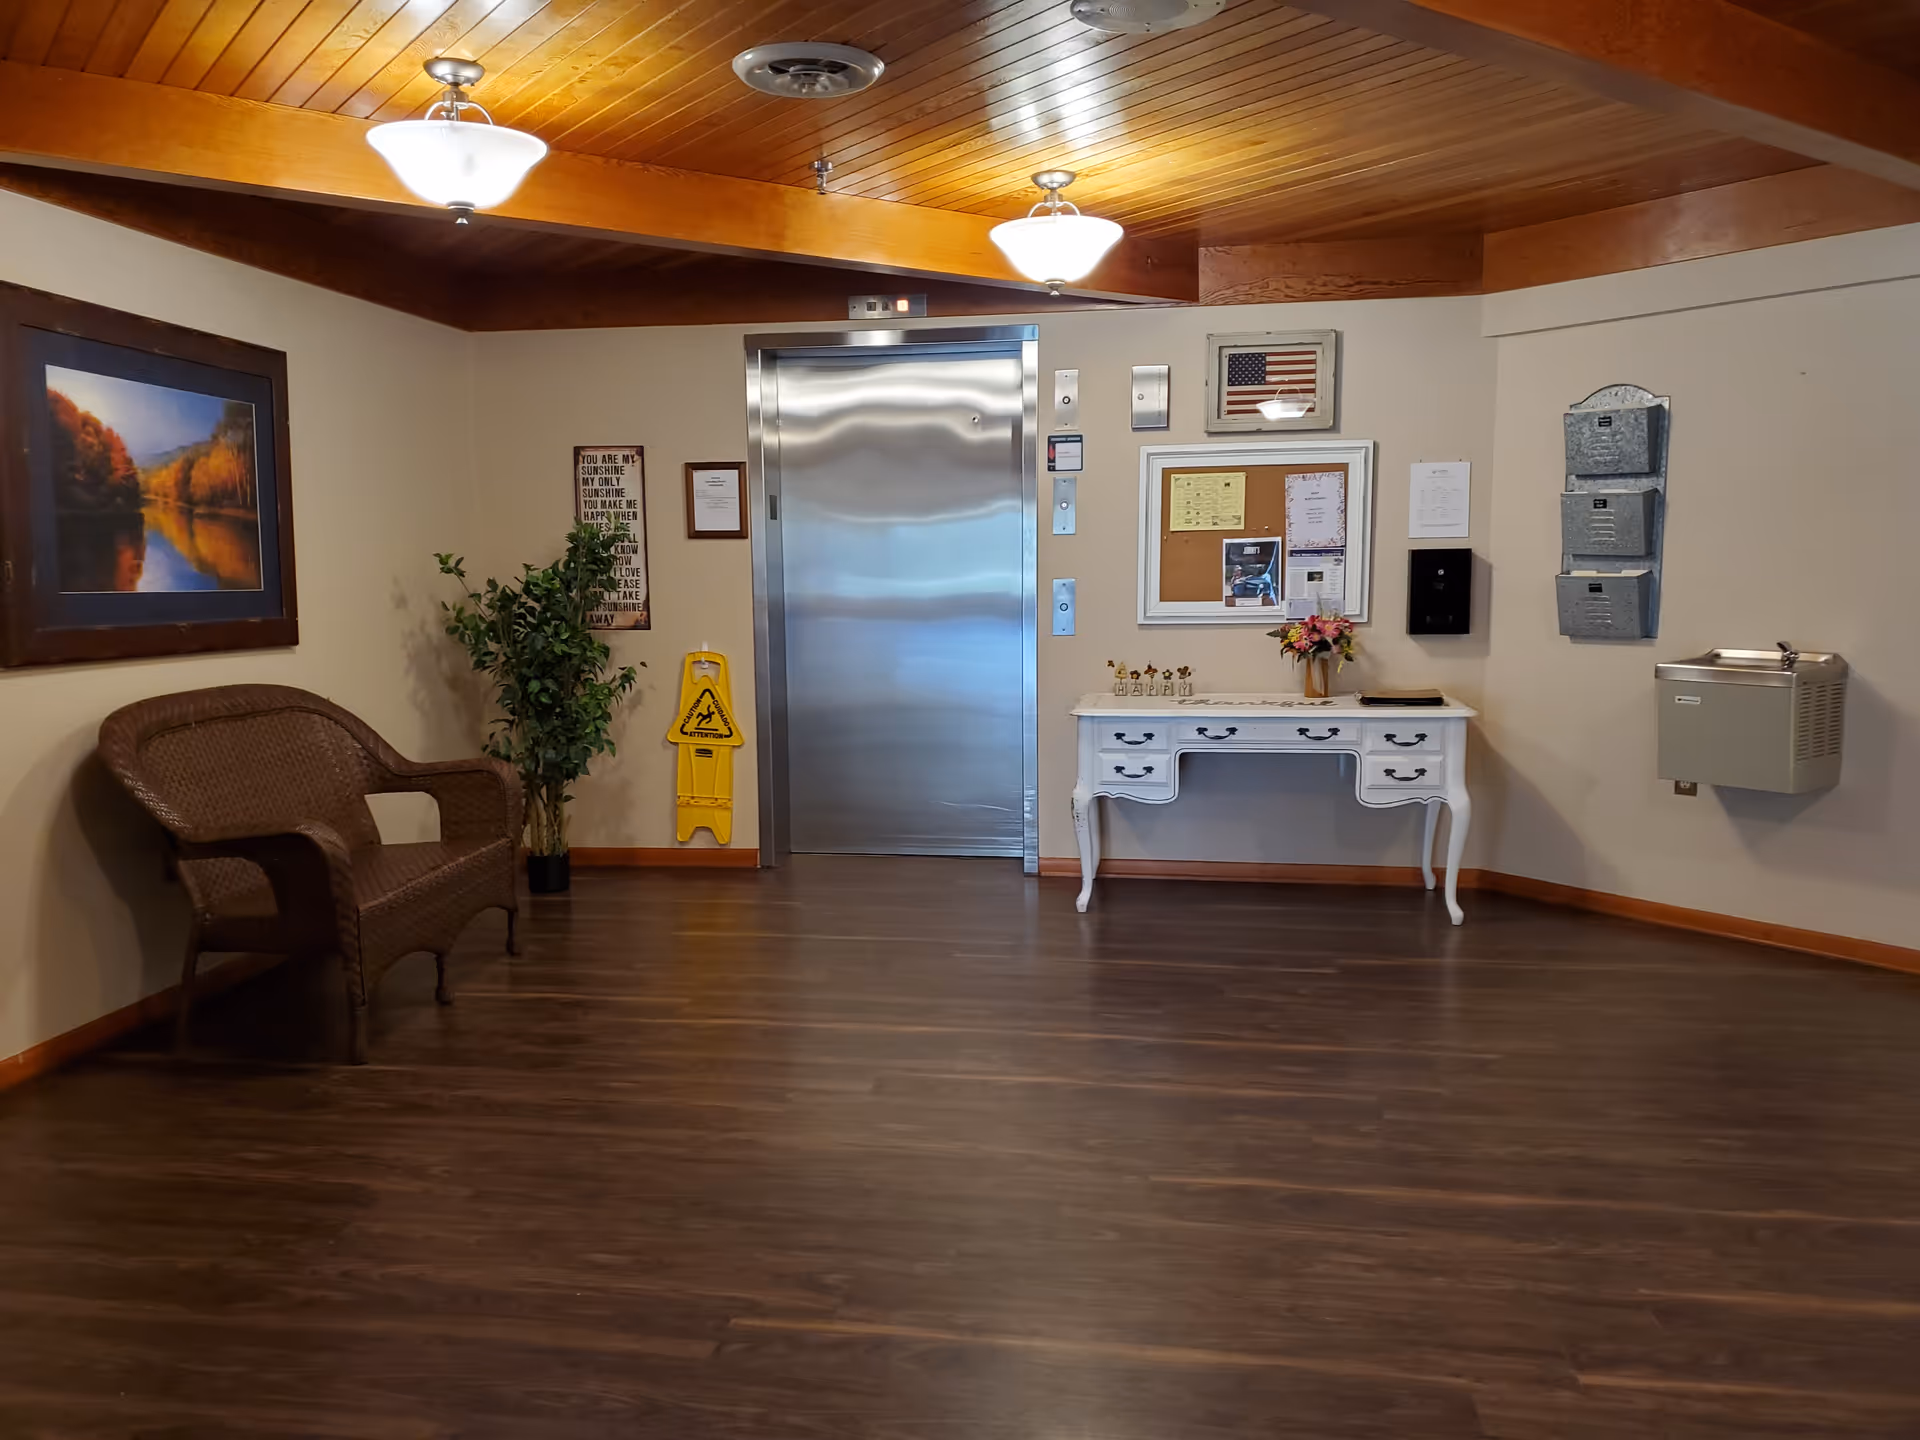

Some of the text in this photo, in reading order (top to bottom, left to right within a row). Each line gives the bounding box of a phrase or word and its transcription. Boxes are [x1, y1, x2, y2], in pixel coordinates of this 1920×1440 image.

[582, 454, 635, 464] YOU ARE MY
[581, 465, 625, 475] SUNSHINE
[582, 477, 620, 487] MY ONLY
[582, 488, 625, 498] SUNSHINE
[583, 499, 637, 509] YOU MAKE ME
[613, 511, 637, 520] WHEN
[583, 522, 610, 532] IES
[614, 544, 638, 554] KNOW
[613, 567, 640, 577] I LOVE
[616, 591, 640, 600] TAKE
[602, 602, 642, 612] SUNSHINE
[589, 614, 614, 624] AWAY
[683, 697, 702, 724] CAUTION
[712, 699, 730, 727] CUIDADO
[689, 731, 723, 739] ATTENTION
